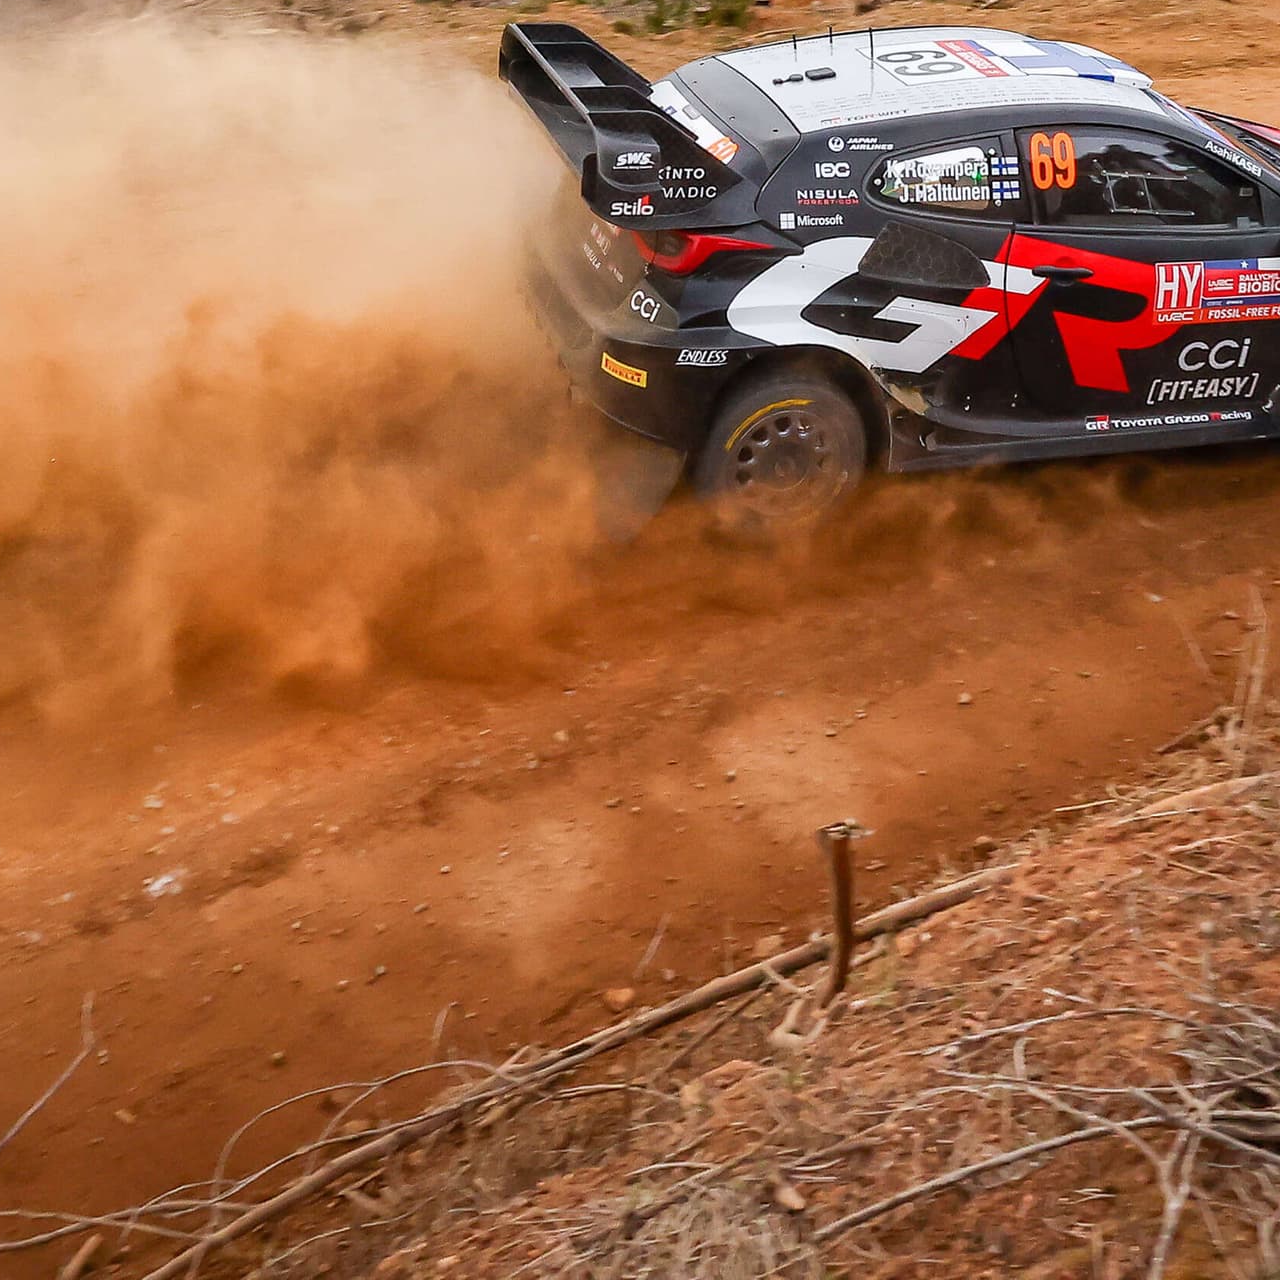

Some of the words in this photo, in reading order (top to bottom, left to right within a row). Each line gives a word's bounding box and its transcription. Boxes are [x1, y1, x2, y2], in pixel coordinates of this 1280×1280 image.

[617, 152, 655, 167] SWS
[1030, 132, 1076, 190] 69
[797, 190, 859, 199] NISULA
[610, 198, 654, 216] Stilo
[797, 214, 844, 226] Microsoft
[1156, 264, 1201, 309] HY
[631, 290, 661, 323] CCi
[1207, 307, 1270, 320] FOSSIL-FREE
[1158, 312, 1194, 322] WRC
[676, 349, 729, 366] ENDLESS
[1178, 337, 1252, 372] CCi
[1085, 415, 1110, 431] GR
